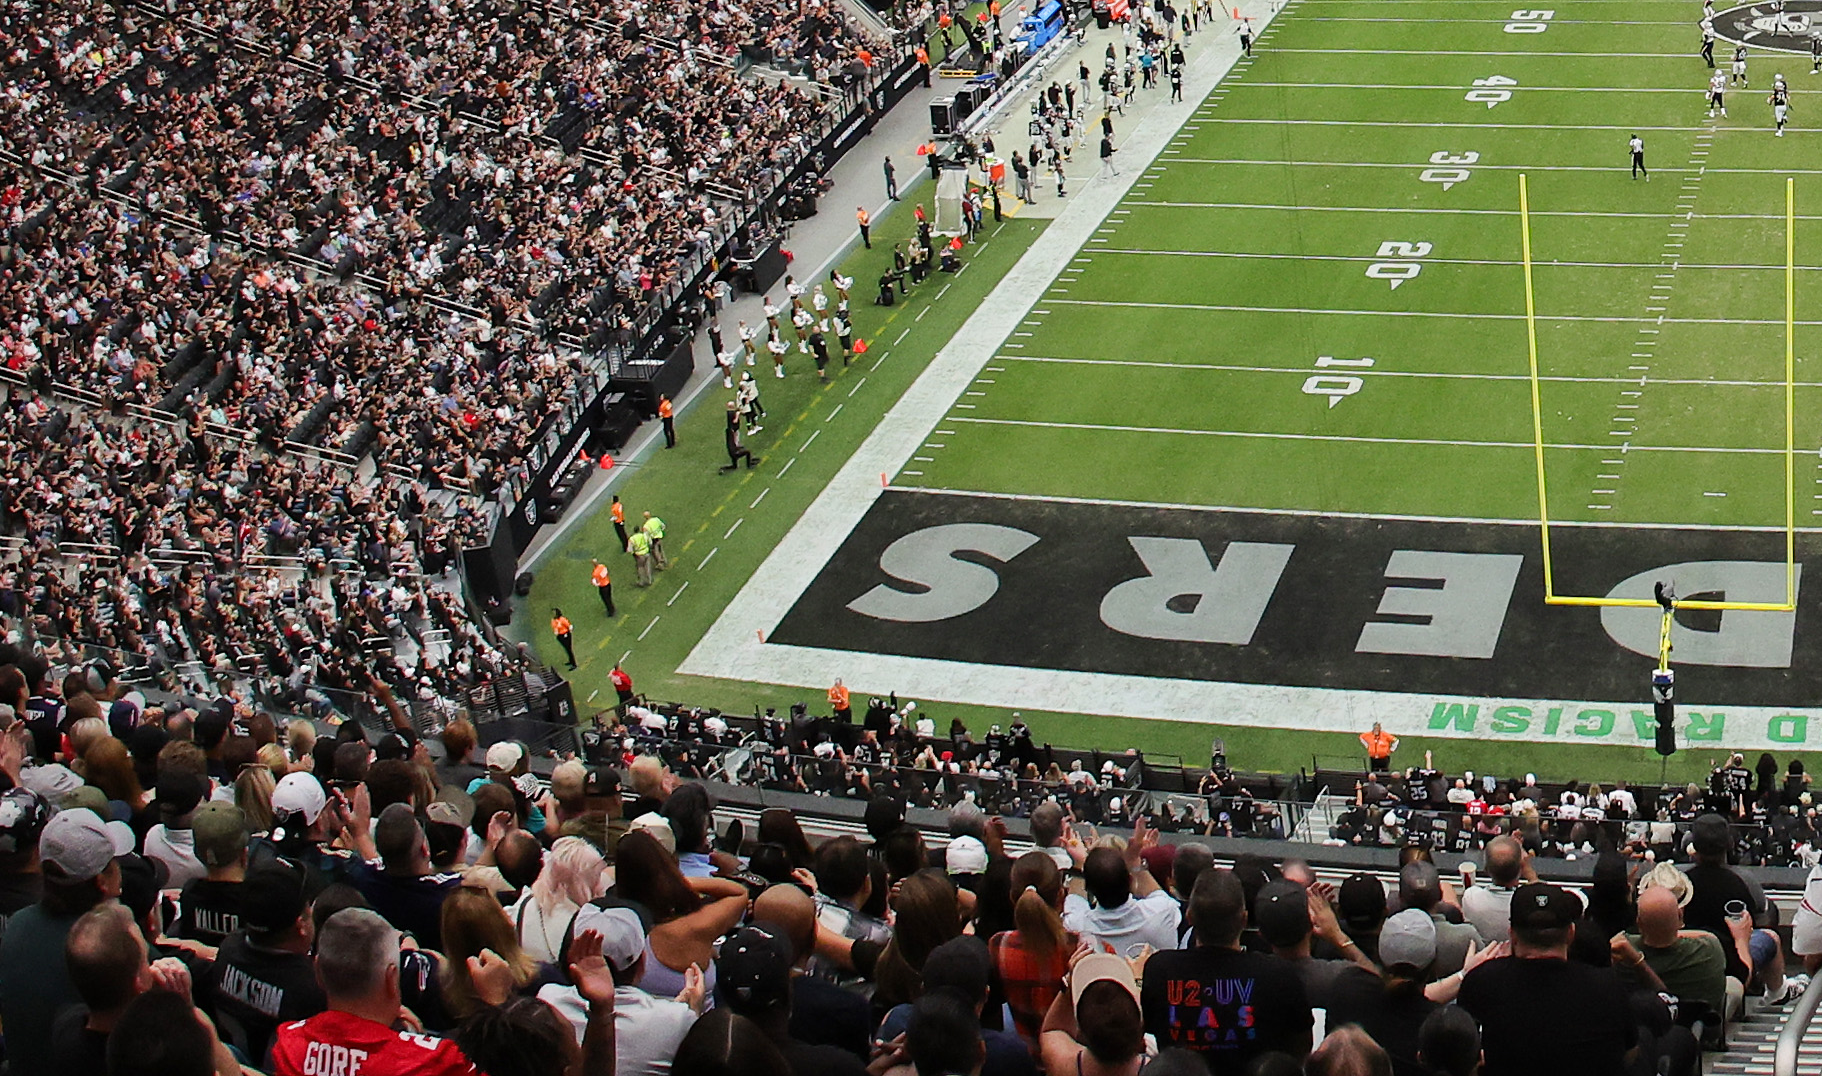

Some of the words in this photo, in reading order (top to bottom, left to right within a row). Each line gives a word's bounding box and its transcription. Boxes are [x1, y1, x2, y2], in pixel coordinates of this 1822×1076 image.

[1503, 9, 1555, 34] 50
[1464, 75, 1518, 102] 40
[1419, 151, 1480, 182] 30
[1365, 241, 1433, 279] 20
[1302, 356, 1376, 396] 10
[1427, 701, 1727, 743] RACISM
[194, 906, 240, 933] WALLER
[219, 962, 285, 1018] JACKSON
[1169, 1005, 1256, 1028] LAS
[1169, 1027, 1256, 1042] VEGAS
[303, 1041, 368, 1076] GORE
